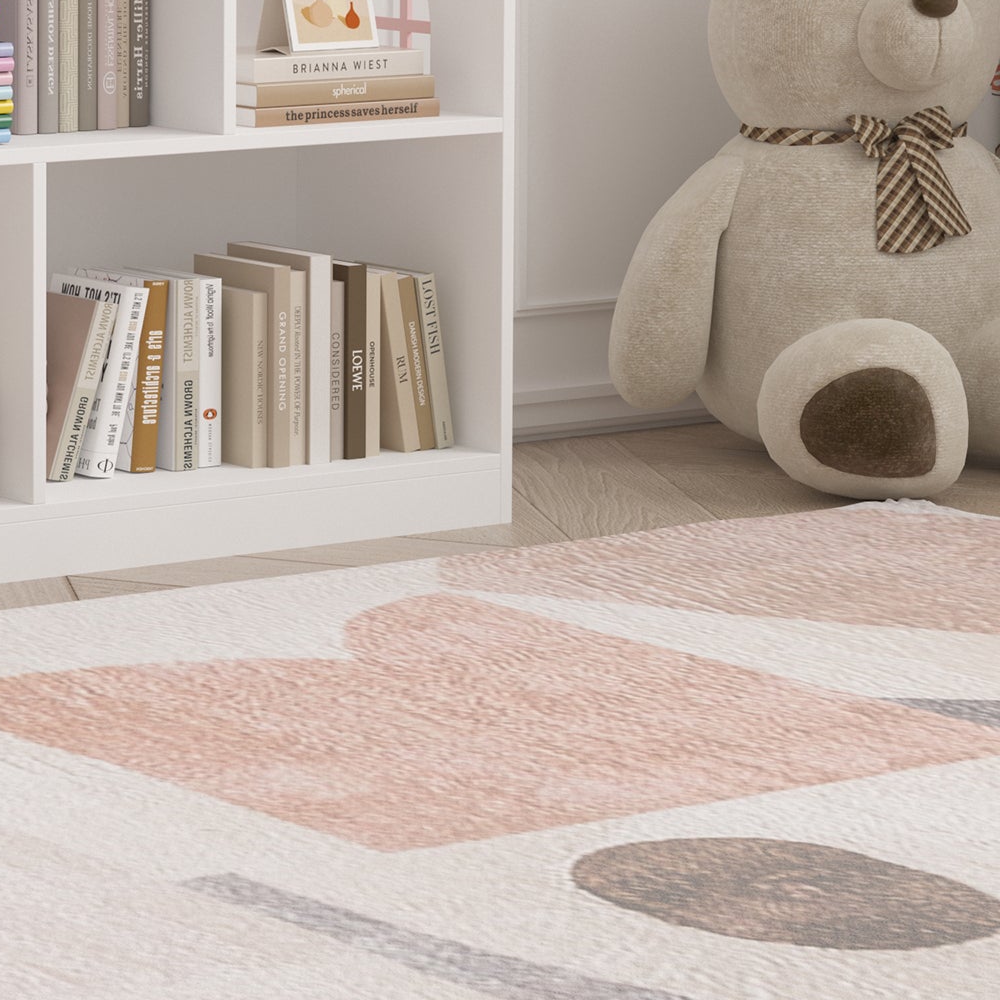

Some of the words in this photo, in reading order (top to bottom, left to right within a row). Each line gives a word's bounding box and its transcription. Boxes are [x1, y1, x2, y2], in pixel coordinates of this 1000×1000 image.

[292, 62, 348, 74] BRIANNA
[353, 59, 388, 70] WIEST
[332, 82, 366, 98] spherical
[286, 110, 304, 121] the
[304, 107, 350, 122] princess
[351, 106, 380, 117] saves
[381, 102, 418, 116] herself
[422, 280, 436, 316] LOST
[294, 306, 302, 330] DEEPLY
[278, 312, 286, 352] GRAND
[408, 321, 418, 348] DANISH
[427, 321, 440, 354] FISH
[332, 332, 340, 410] CONSIDERED
[352, 350, 362, 391] LOEWE
[396, 356, 408, 383] RUM
[412, 349, 422, 380] MODERN
[278, 357, 286, 411] OPENING
[294, 376, 302, 400] POWER
[416, 380, 426, 406] DESIGN
[294, 401, 301, 410] OF
